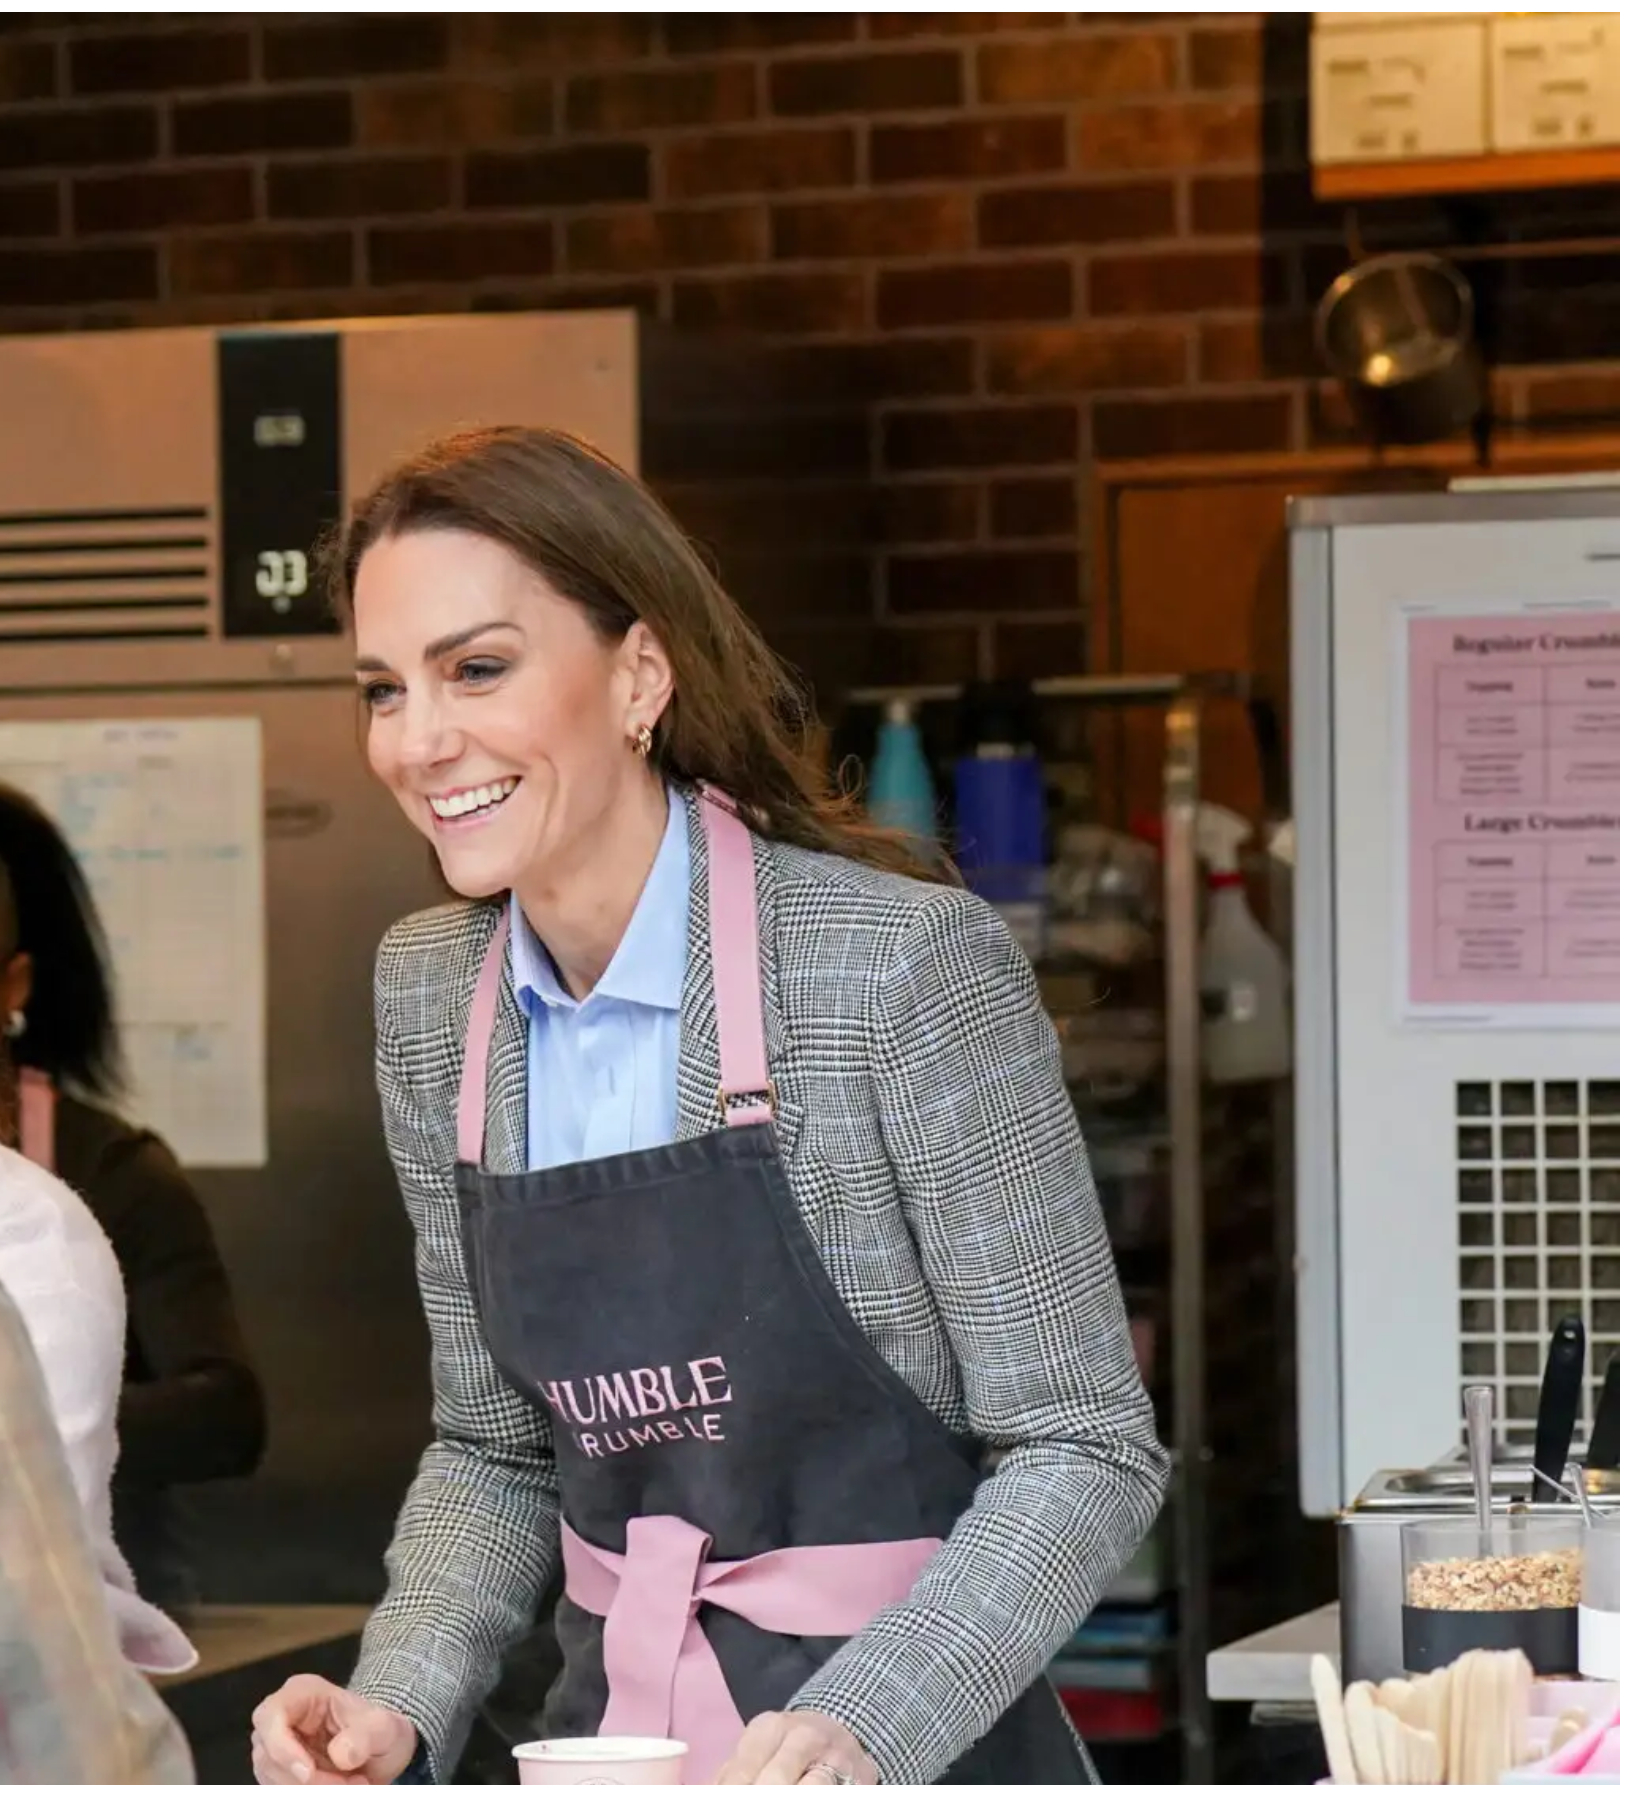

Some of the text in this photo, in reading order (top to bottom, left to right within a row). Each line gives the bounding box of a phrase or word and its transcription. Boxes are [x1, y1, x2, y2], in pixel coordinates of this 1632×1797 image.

[1464, 812, 1524, 834] Large
[536, 1355, 732, 1425] HUMBLE
[572, 1413, 725, 1459] RUMBLE
